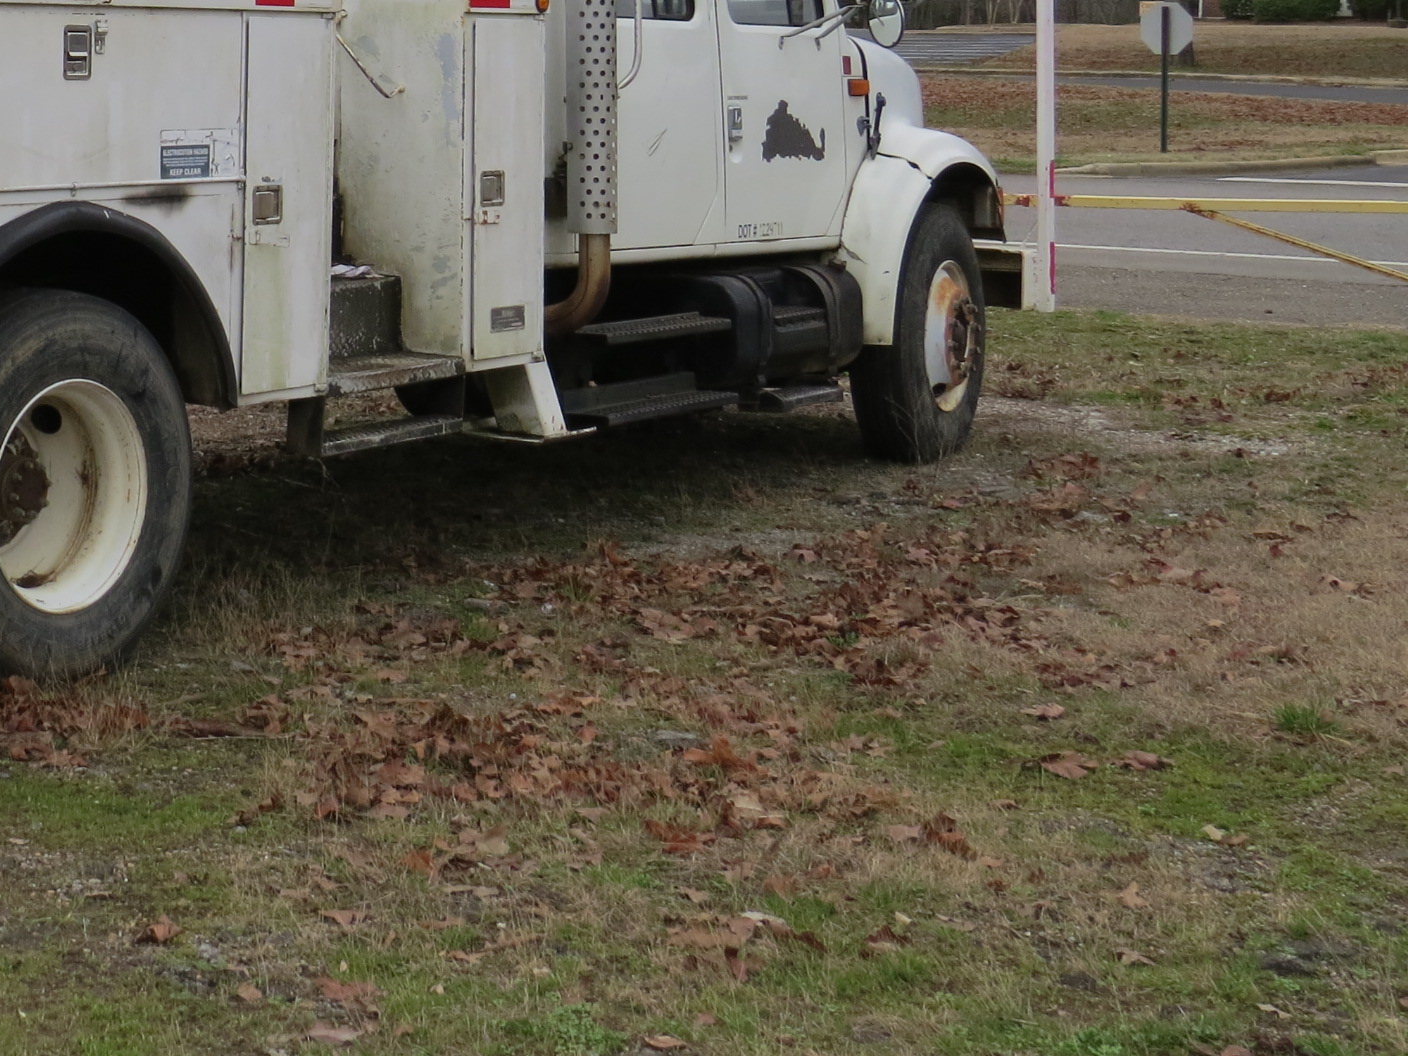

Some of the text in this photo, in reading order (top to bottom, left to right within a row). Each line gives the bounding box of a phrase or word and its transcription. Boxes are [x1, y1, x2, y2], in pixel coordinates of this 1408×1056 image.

[169, 167, 202, 176] KEEP CLEAR
[737, 224, 752, 238] DOT
